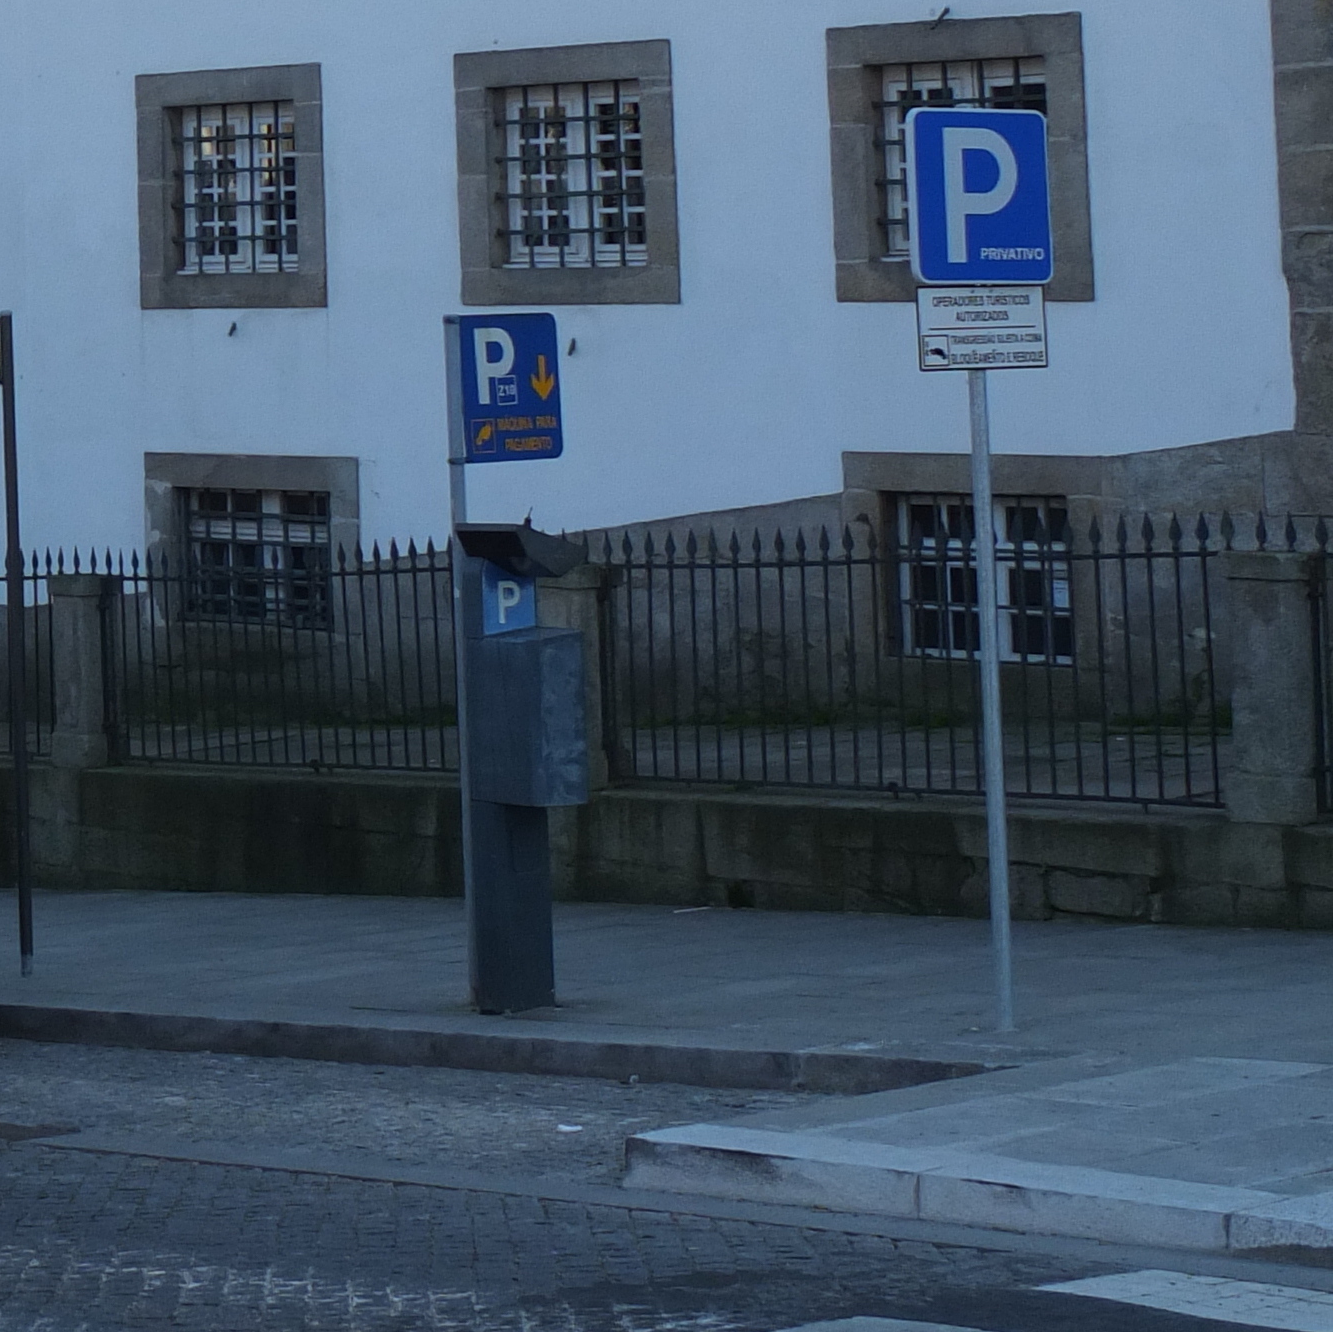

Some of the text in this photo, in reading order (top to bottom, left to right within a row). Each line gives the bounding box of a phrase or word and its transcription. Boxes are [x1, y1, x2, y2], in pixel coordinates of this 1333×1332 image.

[942, 126, 1019, 264] P
[980, 247, 1045, 261] PRIVATIVO
[473, 327, 515, 405] P
[505, 436, 552, 451] PAGAMENTO
[497, 579, 521, 625] P
